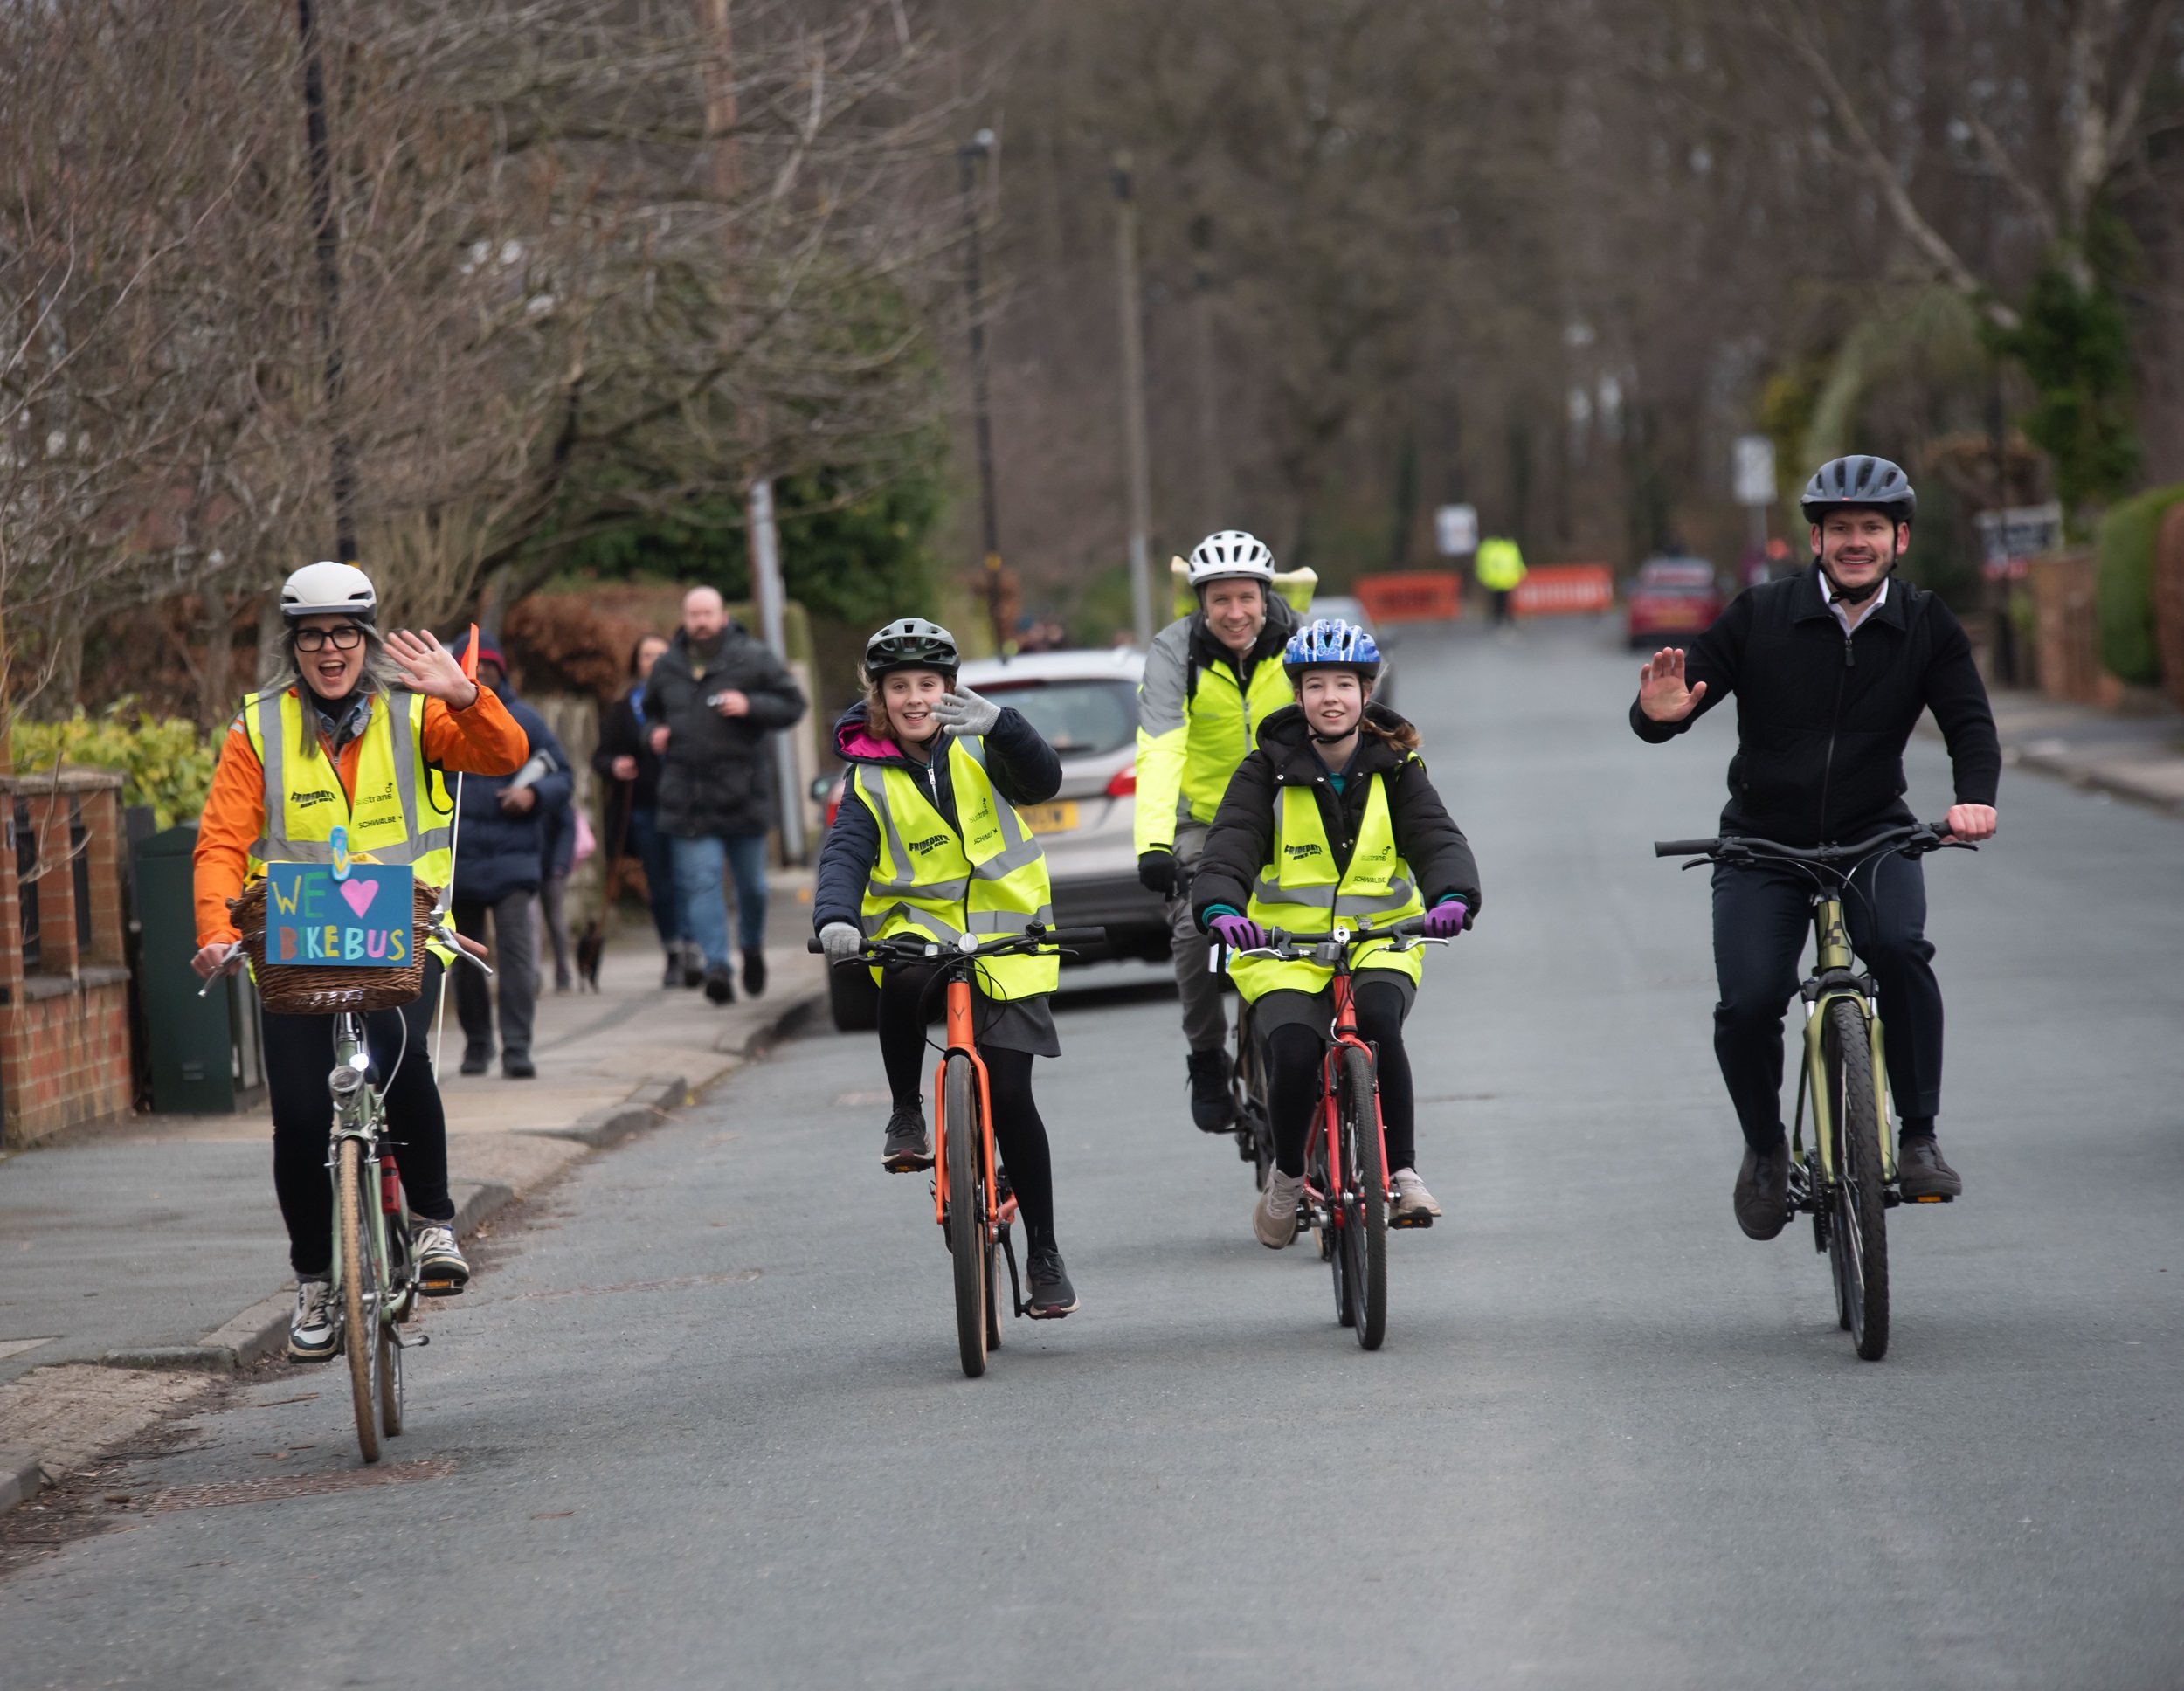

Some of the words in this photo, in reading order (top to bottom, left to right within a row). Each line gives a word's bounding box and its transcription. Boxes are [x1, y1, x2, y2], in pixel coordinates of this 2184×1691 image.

[356, 793, 392, 806] sustrans
[358, 815, 397, 829] SCHWALBE
[271, 871, 328, 918] WE
